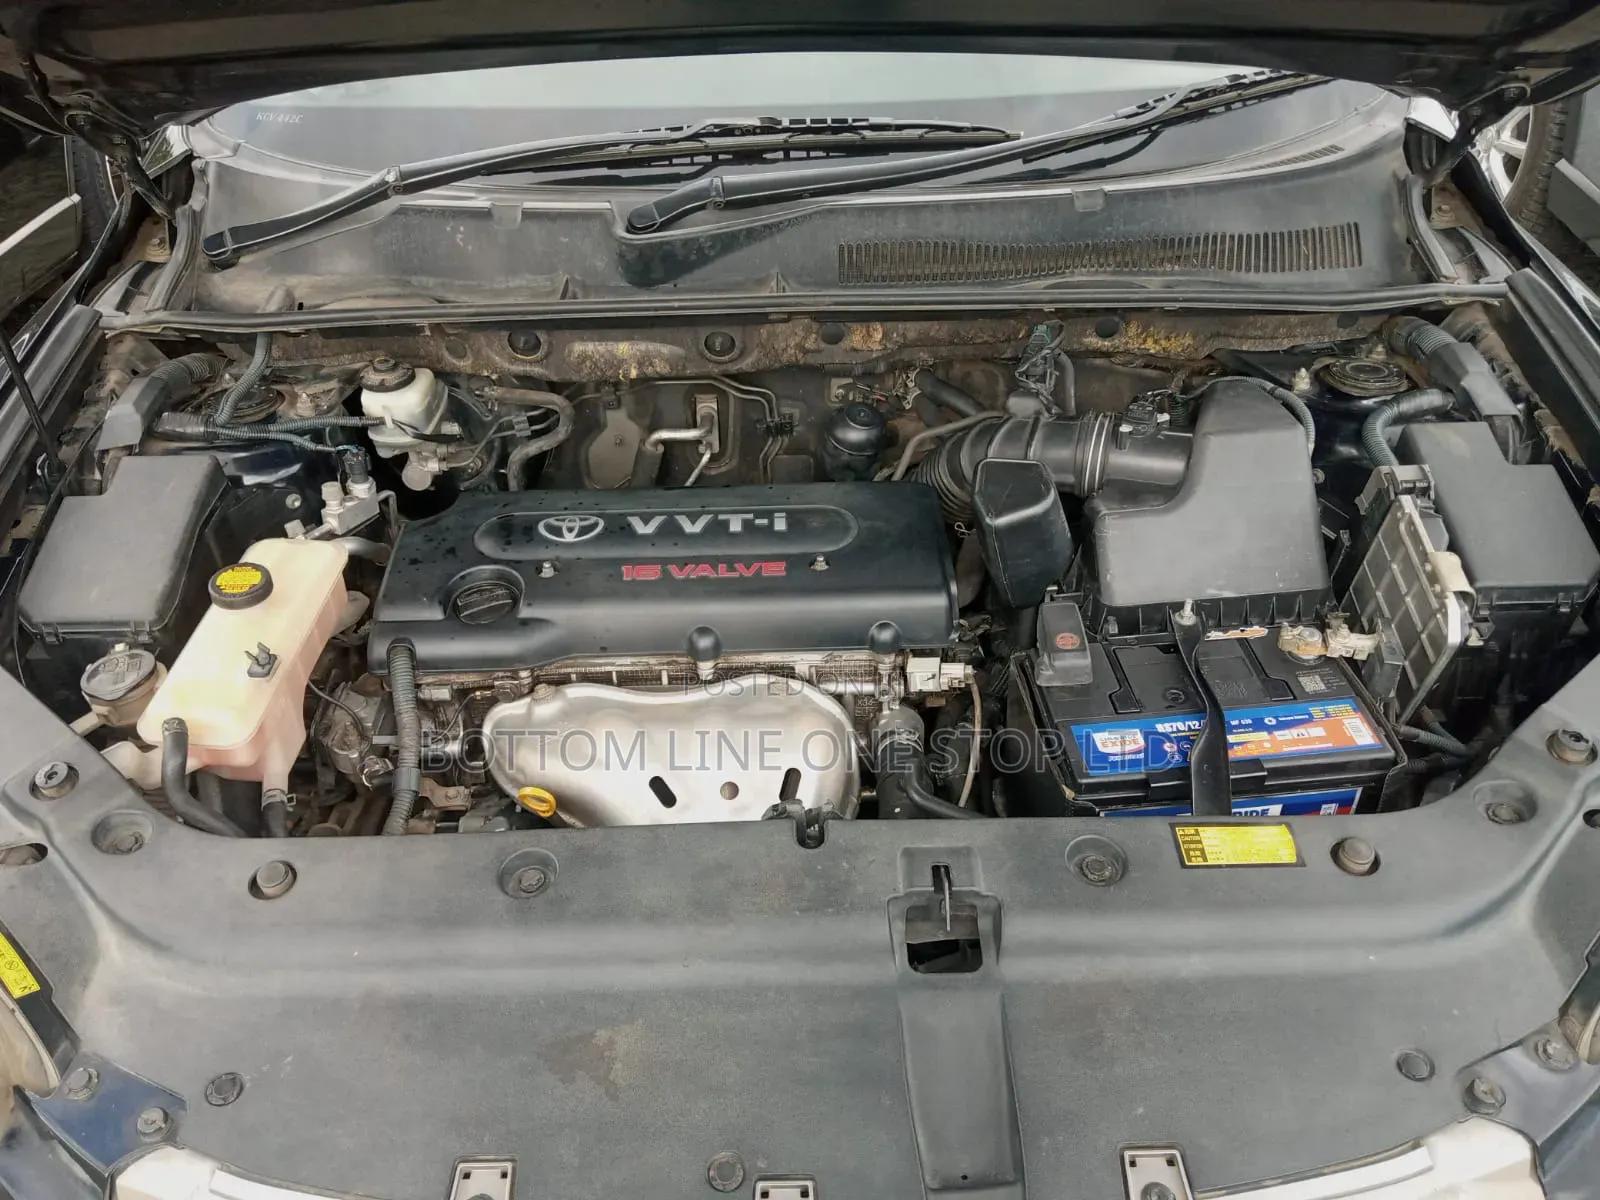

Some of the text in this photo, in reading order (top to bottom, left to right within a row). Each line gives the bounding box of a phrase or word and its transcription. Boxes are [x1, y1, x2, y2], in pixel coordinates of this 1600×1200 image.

[627, 512, 788, 534] VVT-i
[622, 561, 787, 580] 16 VALVE
